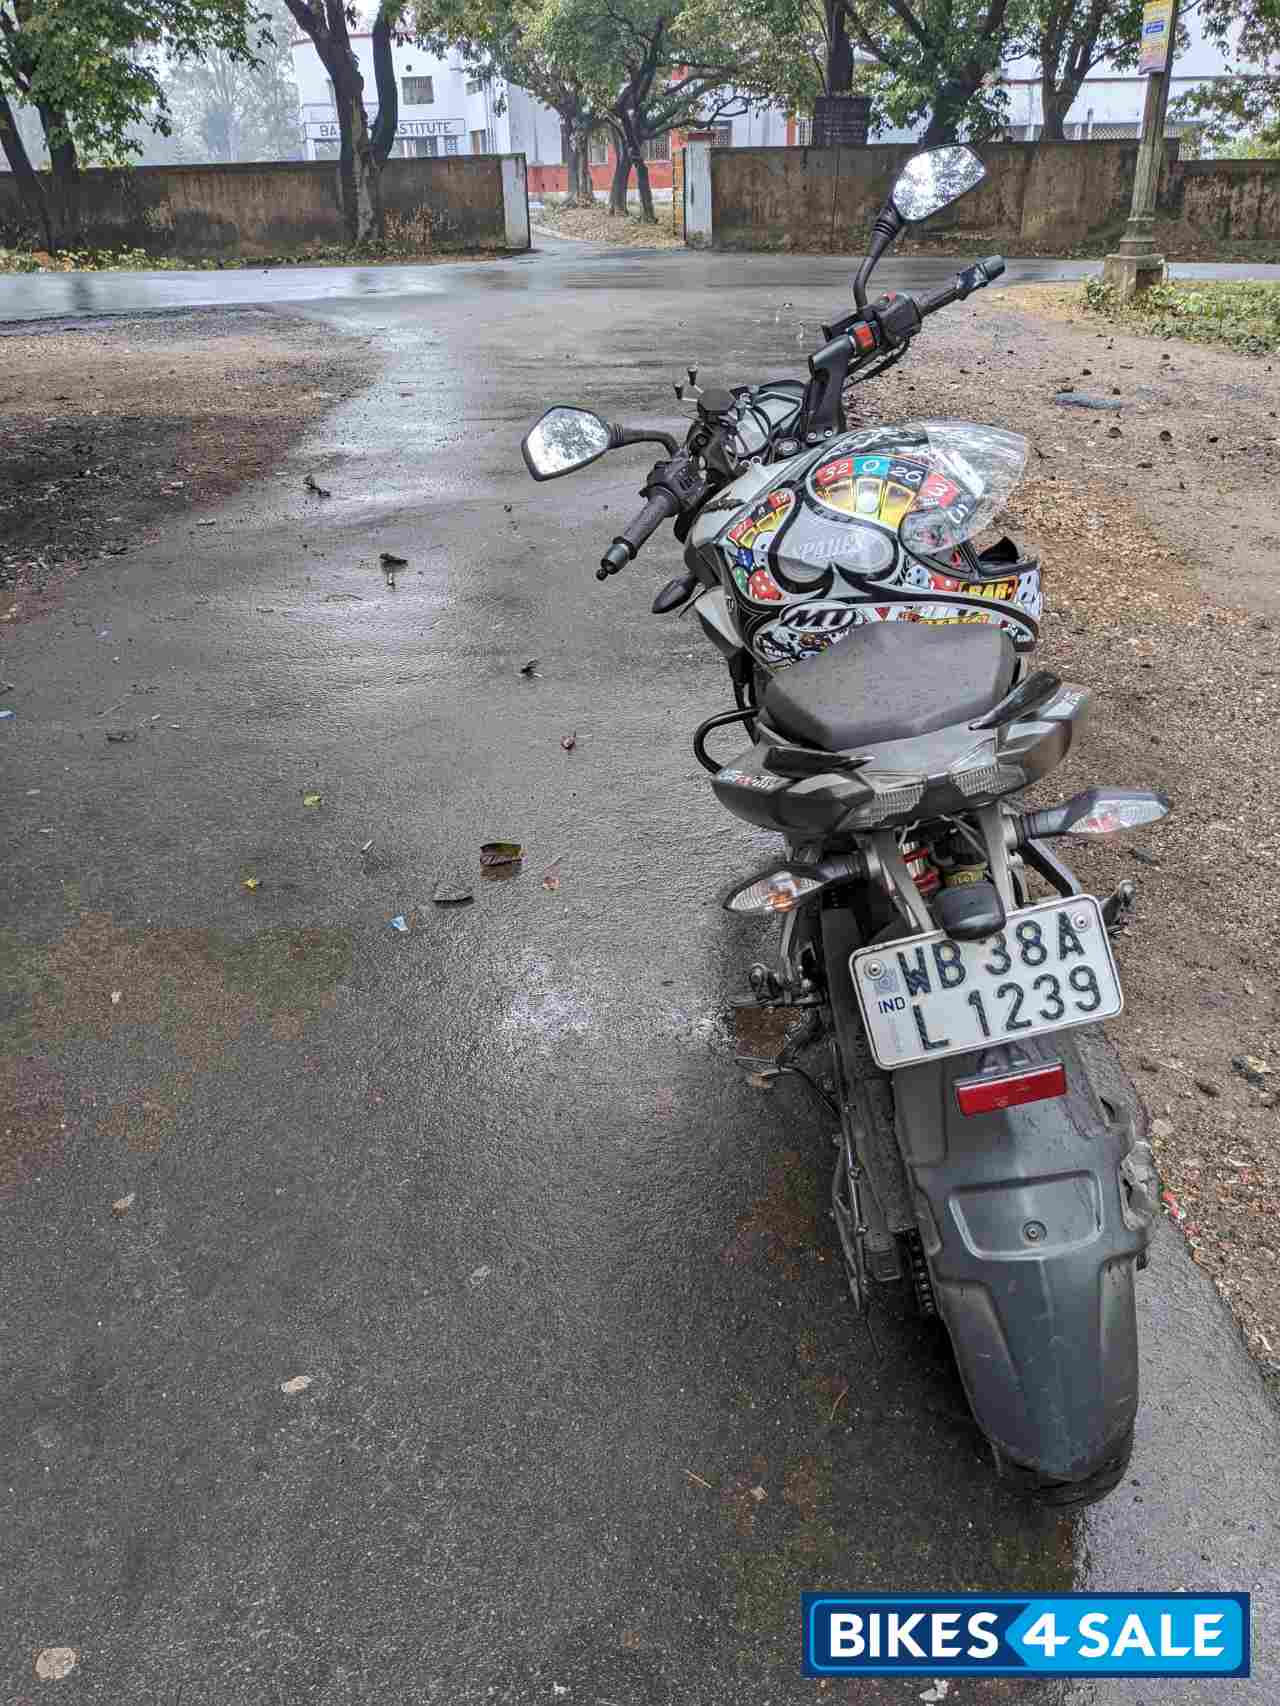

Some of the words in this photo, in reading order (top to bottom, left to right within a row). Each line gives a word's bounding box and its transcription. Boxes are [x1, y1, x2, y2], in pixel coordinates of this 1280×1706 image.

[399, 122, 451, 135] STITUTE
[896, 940, 966, 996] WB
[985, 911, 1085, 976] 38A
[878, 996, 906, 1014] IND
[912, 1005, 951, 1050] L
[967, 964, 1102, 1037] 1239
